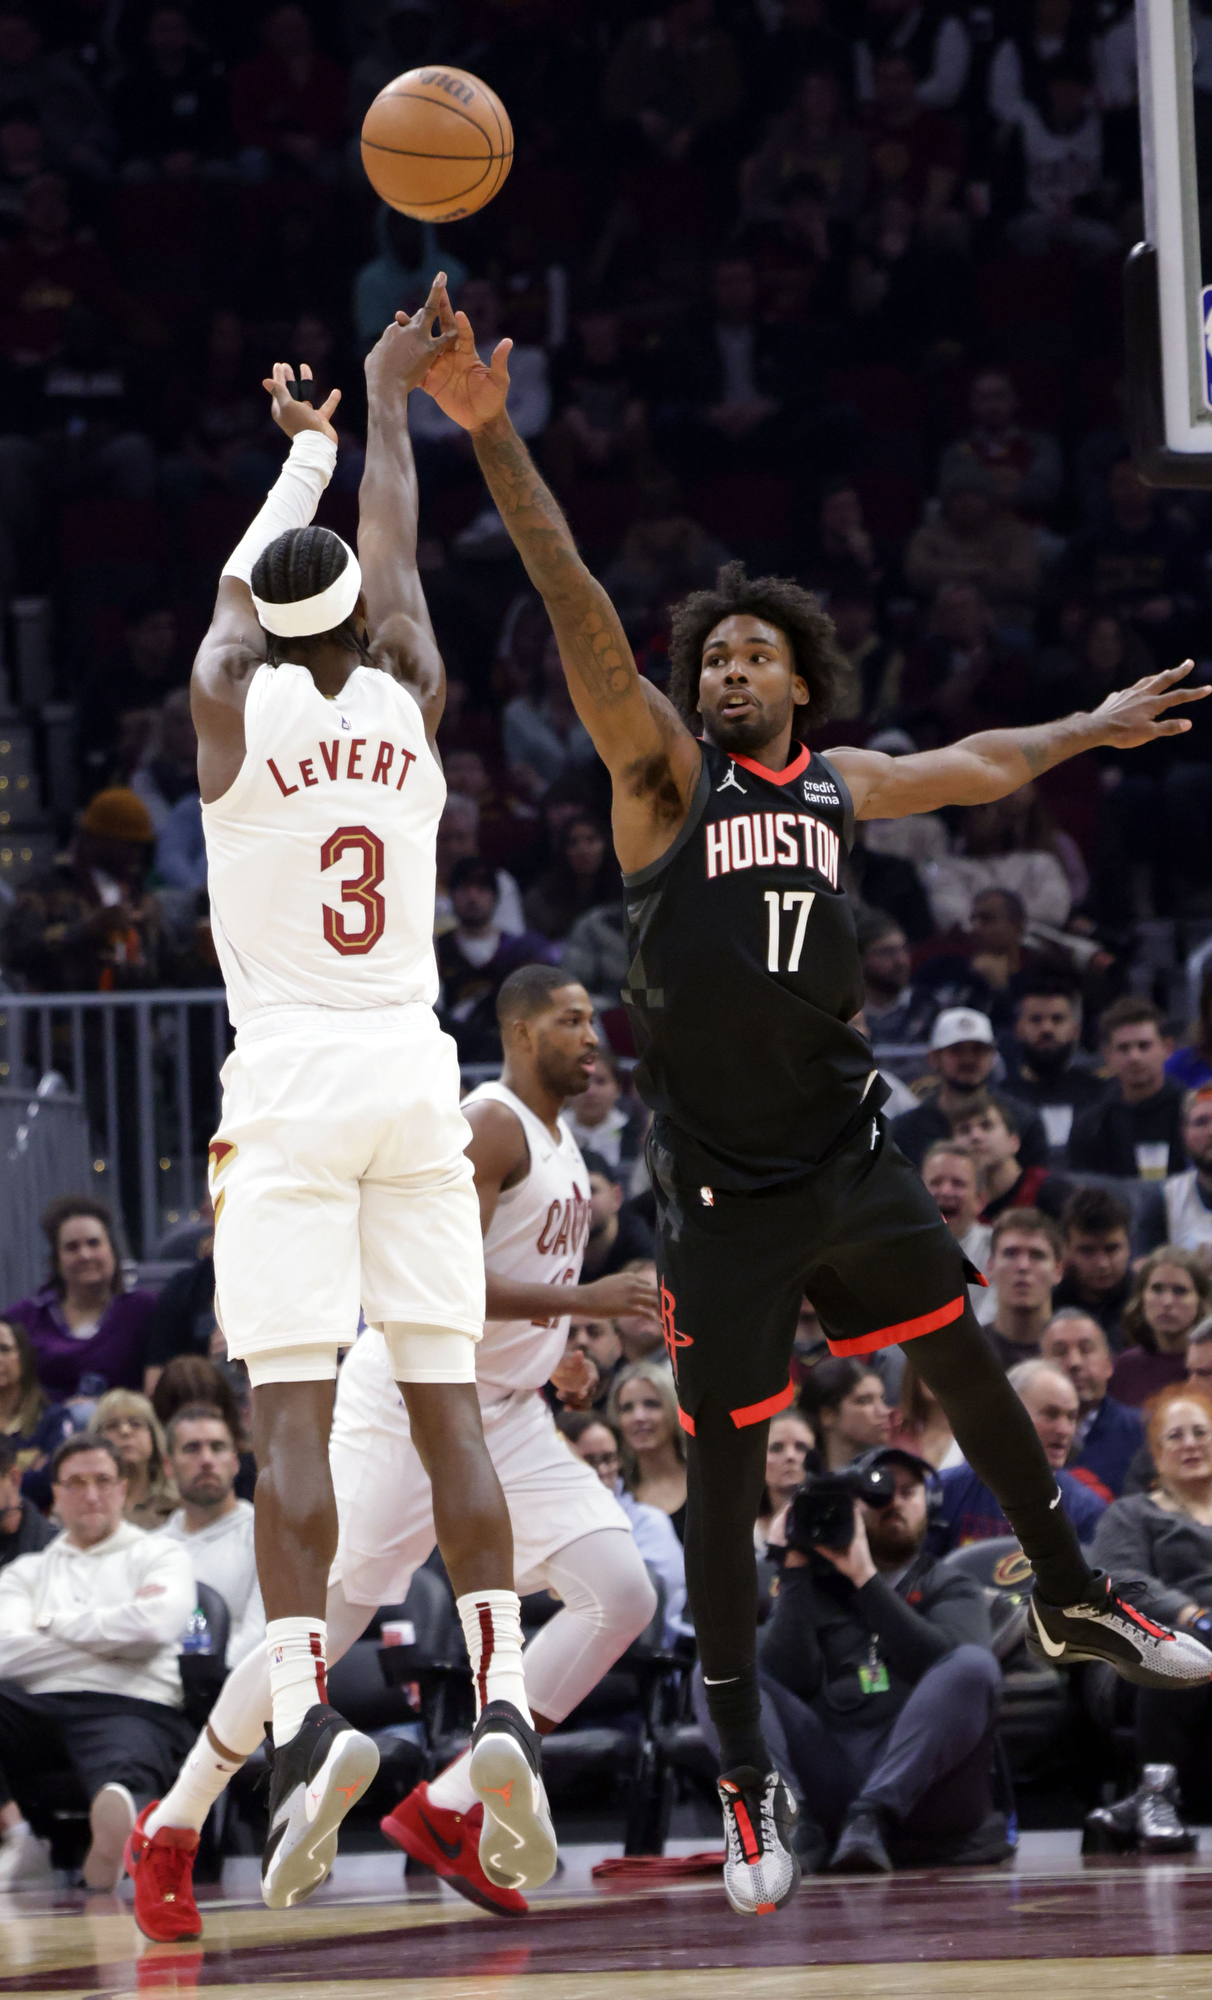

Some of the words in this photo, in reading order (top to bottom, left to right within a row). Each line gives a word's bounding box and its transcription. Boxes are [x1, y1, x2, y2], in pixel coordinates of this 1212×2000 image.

[803, 780, 837, 793] credit
[803, 789, 840, 805] karma
[320, 825, 386, 956] 3
[706, 812, 840, 891] HOUSTON
[764, 891, 816, 972] 17
